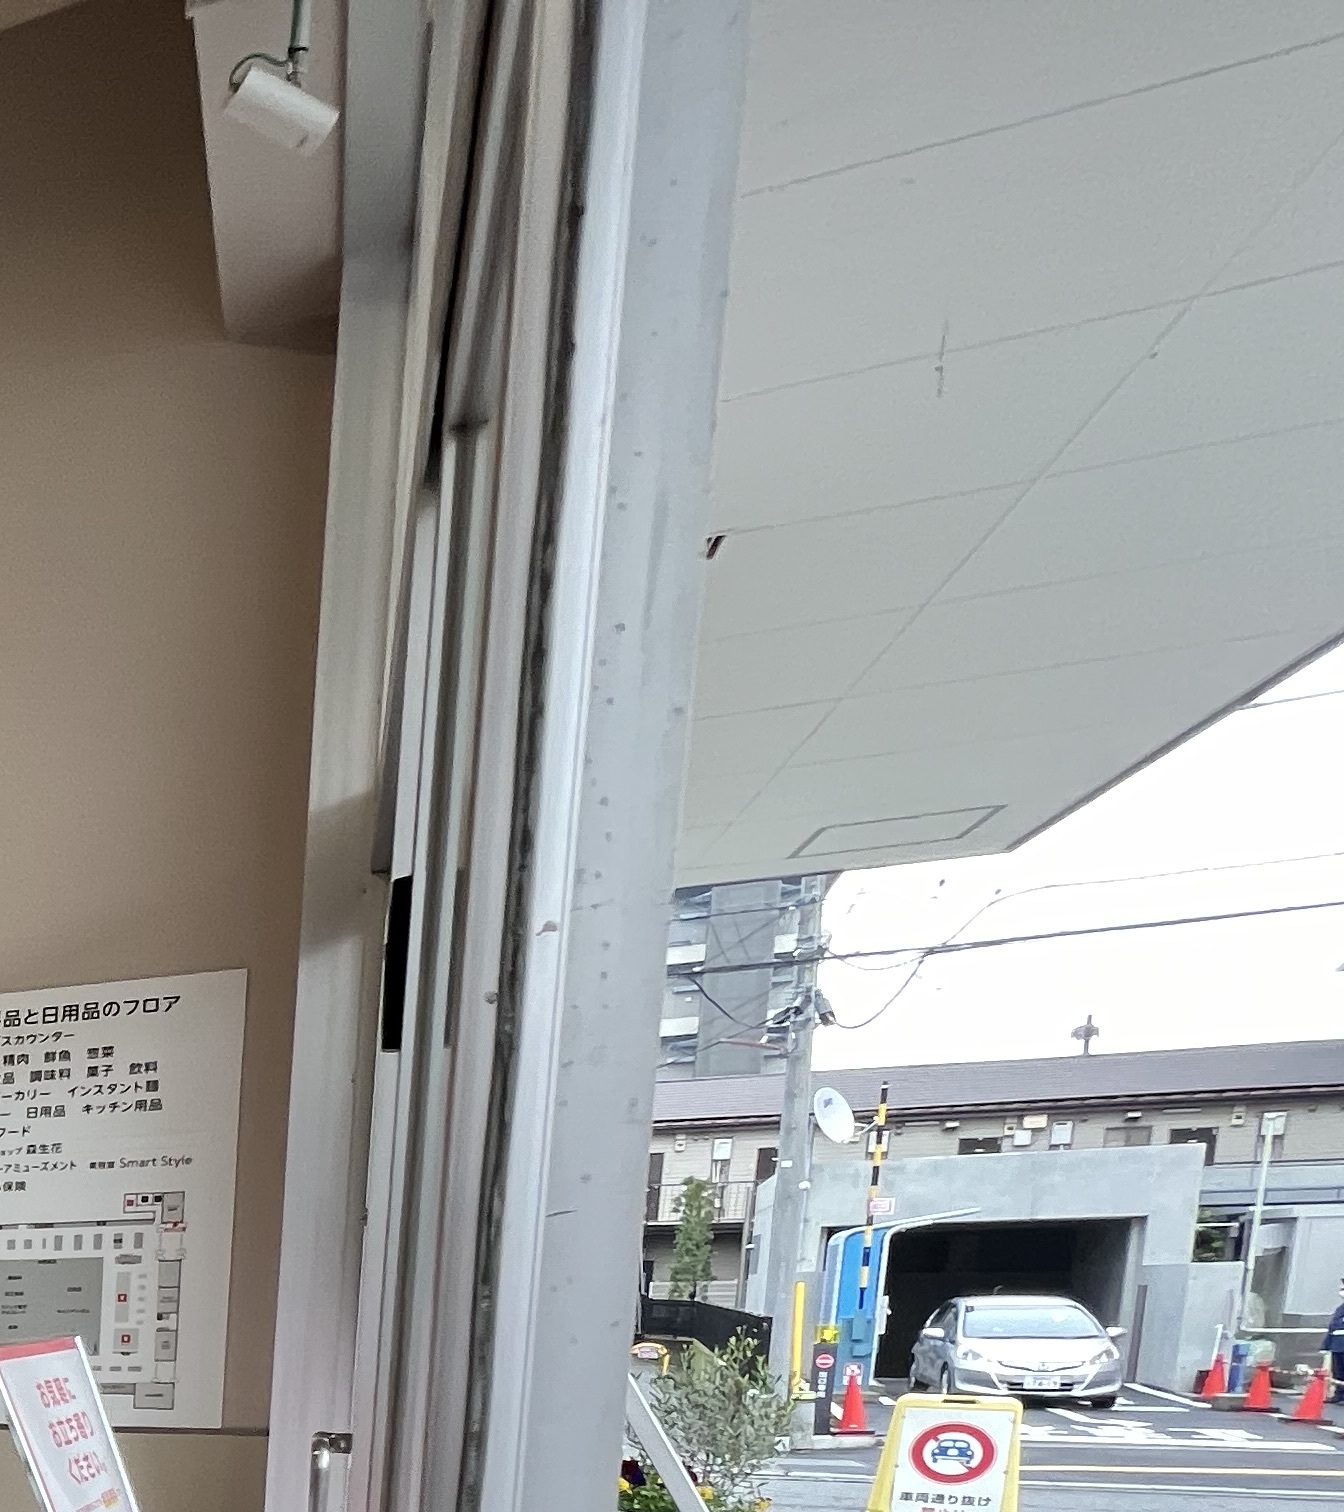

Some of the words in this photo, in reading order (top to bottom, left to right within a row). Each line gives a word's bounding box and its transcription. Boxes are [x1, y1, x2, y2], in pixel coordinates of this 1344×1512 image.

[128, 1060, 159, 1076] 飲料
[26, 1104, 66, 1119] 日用品
[81, 1098, 163, 1115] キッチン用品
[119, 1157, 157, 1169] Smart
[161, 1155, 193, 1169] Style
[898, 1490, 992, 1508] 車両通り抜け
